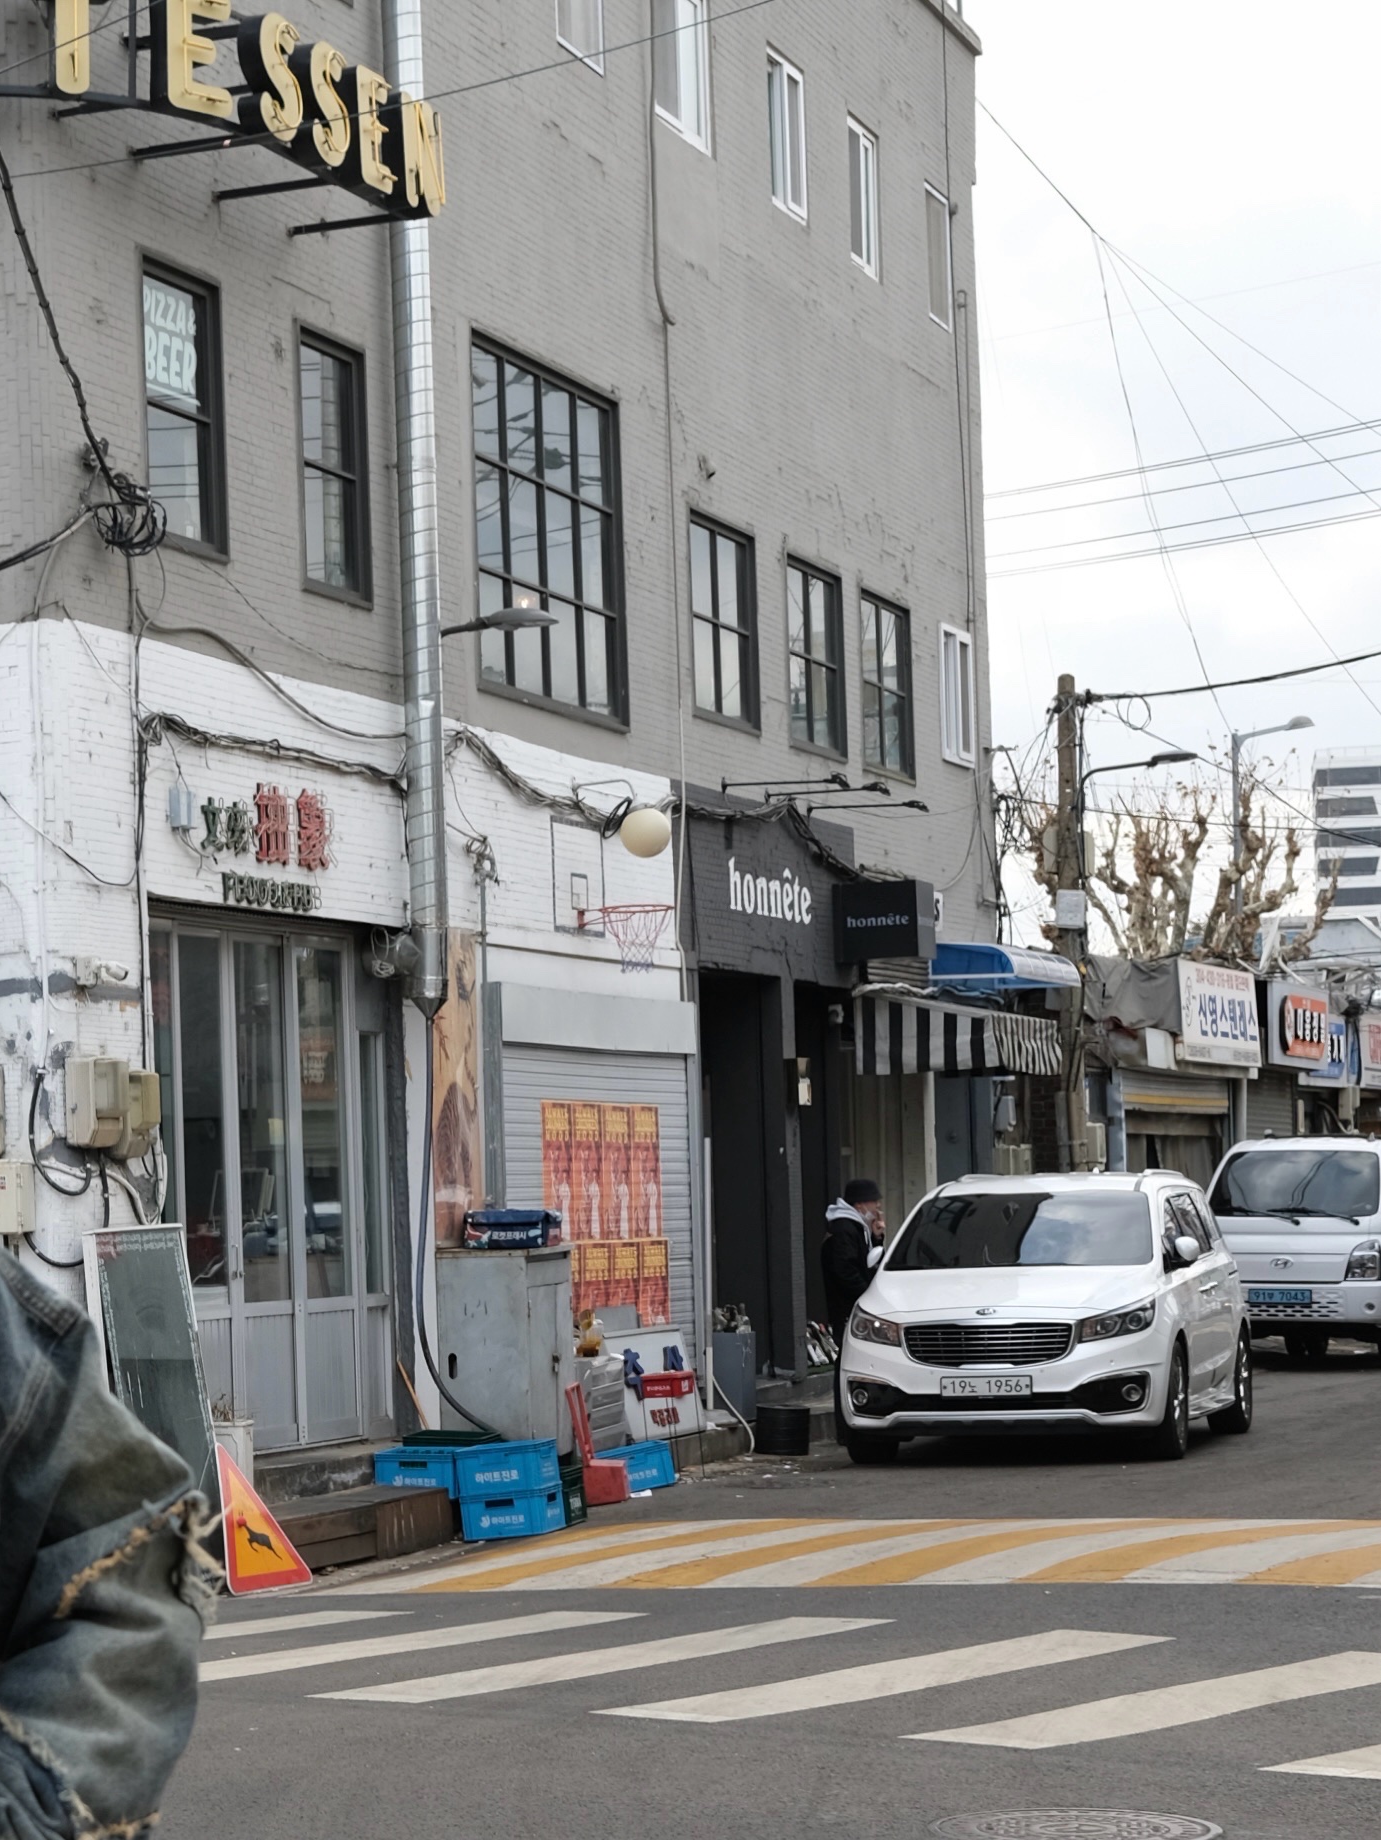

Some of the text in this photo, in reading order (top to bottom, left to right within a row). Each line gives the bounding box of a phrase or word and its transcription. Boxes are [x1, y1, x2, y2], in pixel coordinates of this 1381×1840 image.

[145, 325, 198, 396] BEER
[728, 856, 813, 926] honnête
[846, 912, 910, 929] honnête
[1278, 1291, 1306, 1302] 7043
[950, 1379, 1023, 1394] 19노 1956
[403, 1477, 437, 1487] 하이트진로
[474, 1469, 520, 1484] 하이트진로
[491, 1514, 525, 1525] 하이트진로
